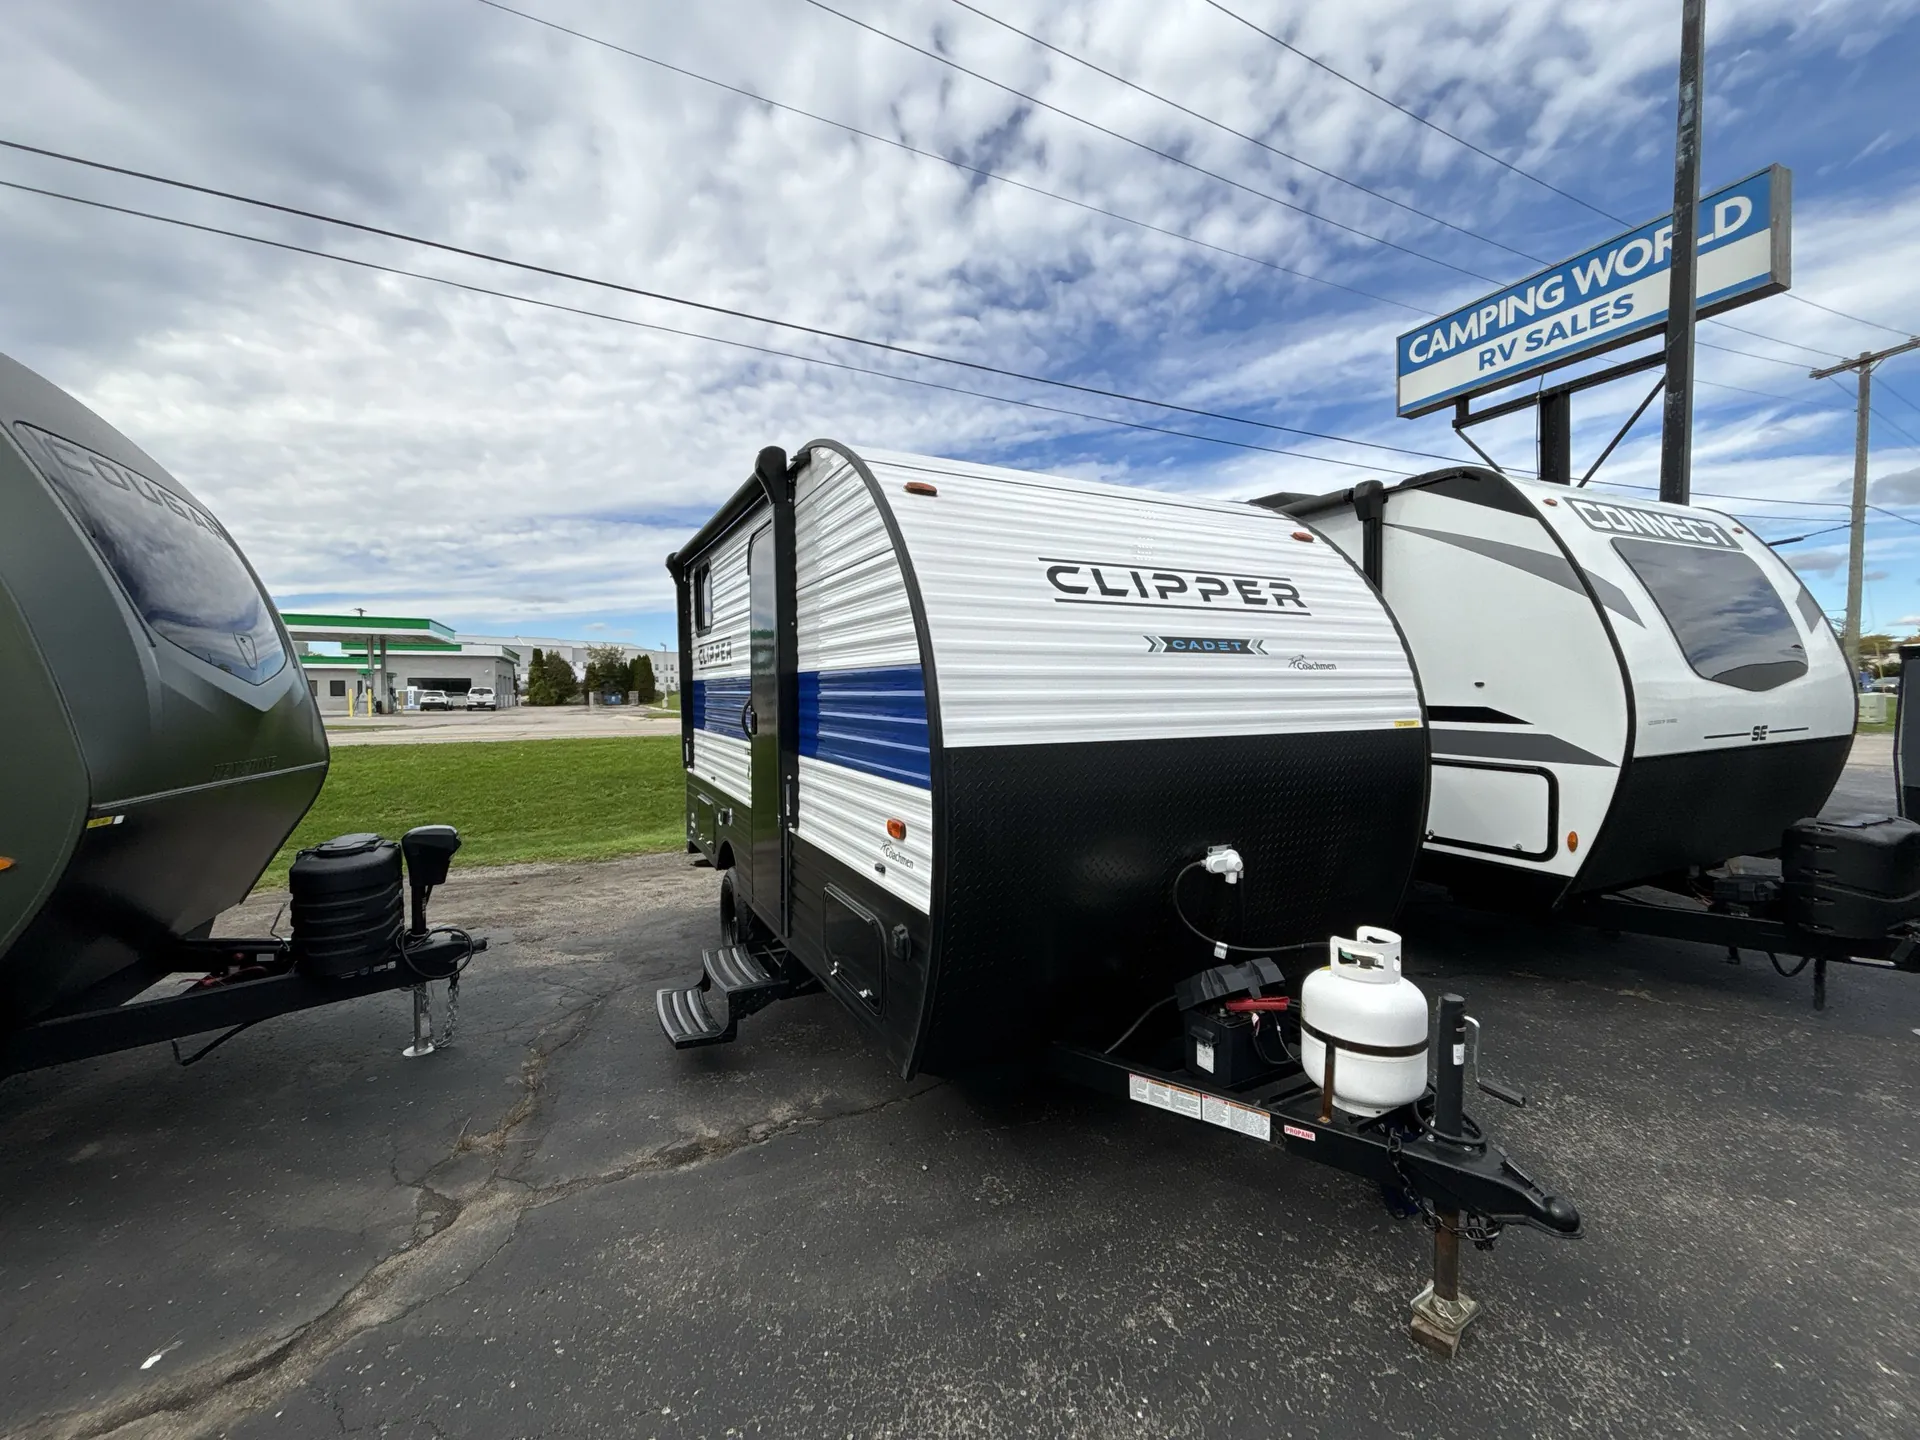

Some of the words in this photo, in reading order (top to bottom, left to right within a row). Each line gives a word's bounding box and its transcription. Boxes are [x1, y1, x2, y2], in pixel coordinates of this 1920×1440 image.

[1409, 275, 1564, 363] CAMPING
[1479, 337, 1517, 371] RV
[1525, 293, 1634, 351] SALES
[1572, 501, 1732, 546] CONNECT
[1046, 565, 1308, 607] CLIPPER
[698, 641, 732, 665] CLIPPER
[1172, 640, 1242, 651] CADET
[1297, 661, 1337, 670] Coachmen
[1751, 726, 1768, 741] SE
[886, 847, 914, 869] Coachmen
[1285, 1127, 1315, 1140] PROPANE
